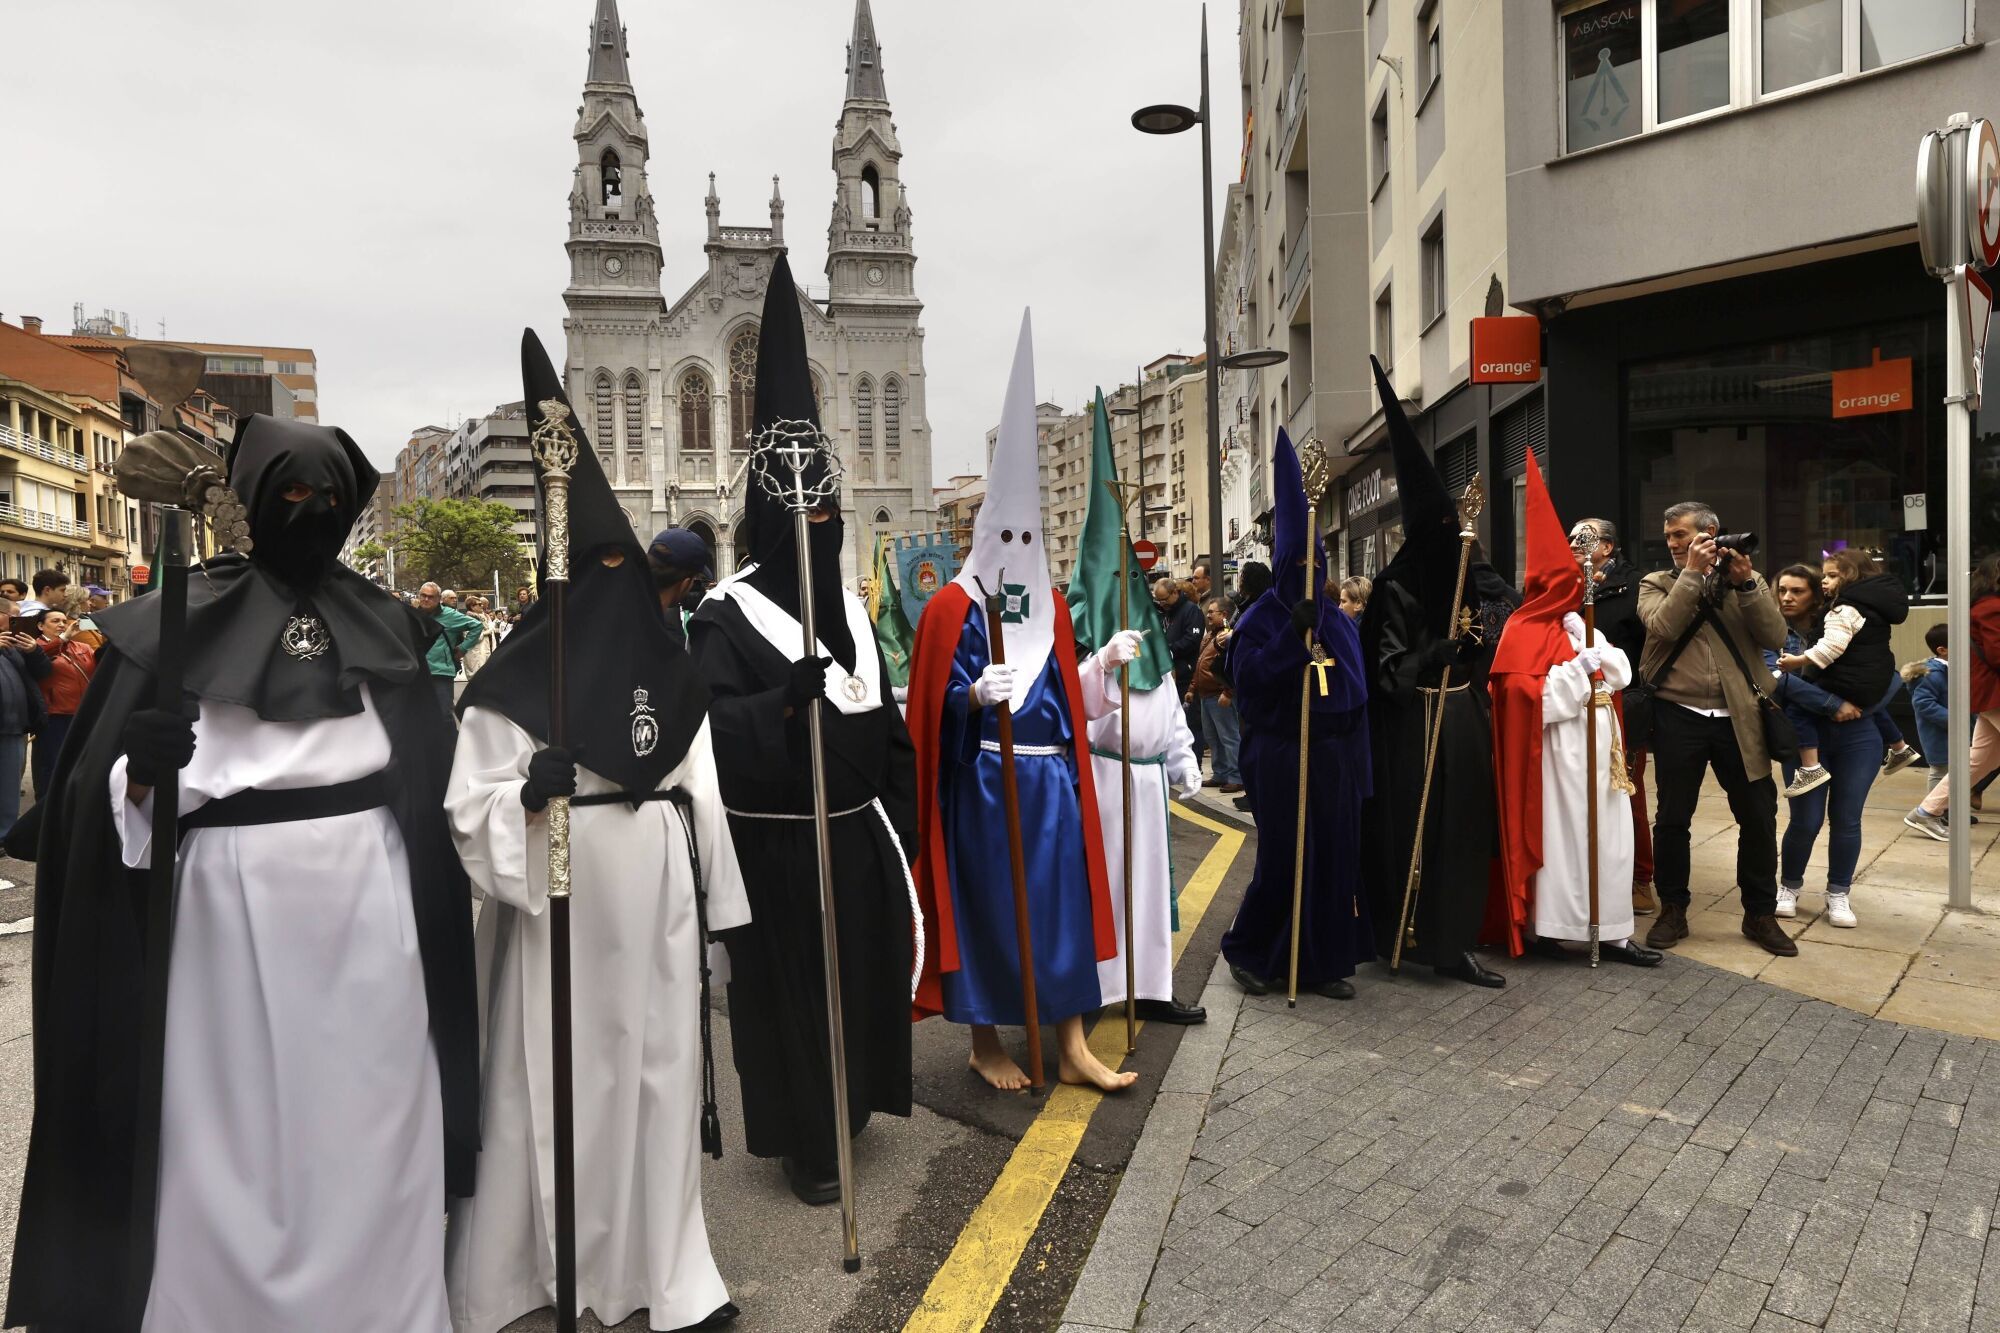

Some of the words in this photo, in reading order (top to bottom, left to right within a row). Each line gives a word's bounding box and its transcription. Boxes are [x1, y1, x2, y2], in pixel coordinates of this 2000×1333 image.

[1573, 8, 1635, 38] ABASCAL
[1480, 362, 1532, 376] orange
[1839, 392, 1901, 409] orange
[1348, 482, 1361, 515] ONE
[1362, 468, 1381, 508] FOOT
[1905, 495, 1925, 508] 05
